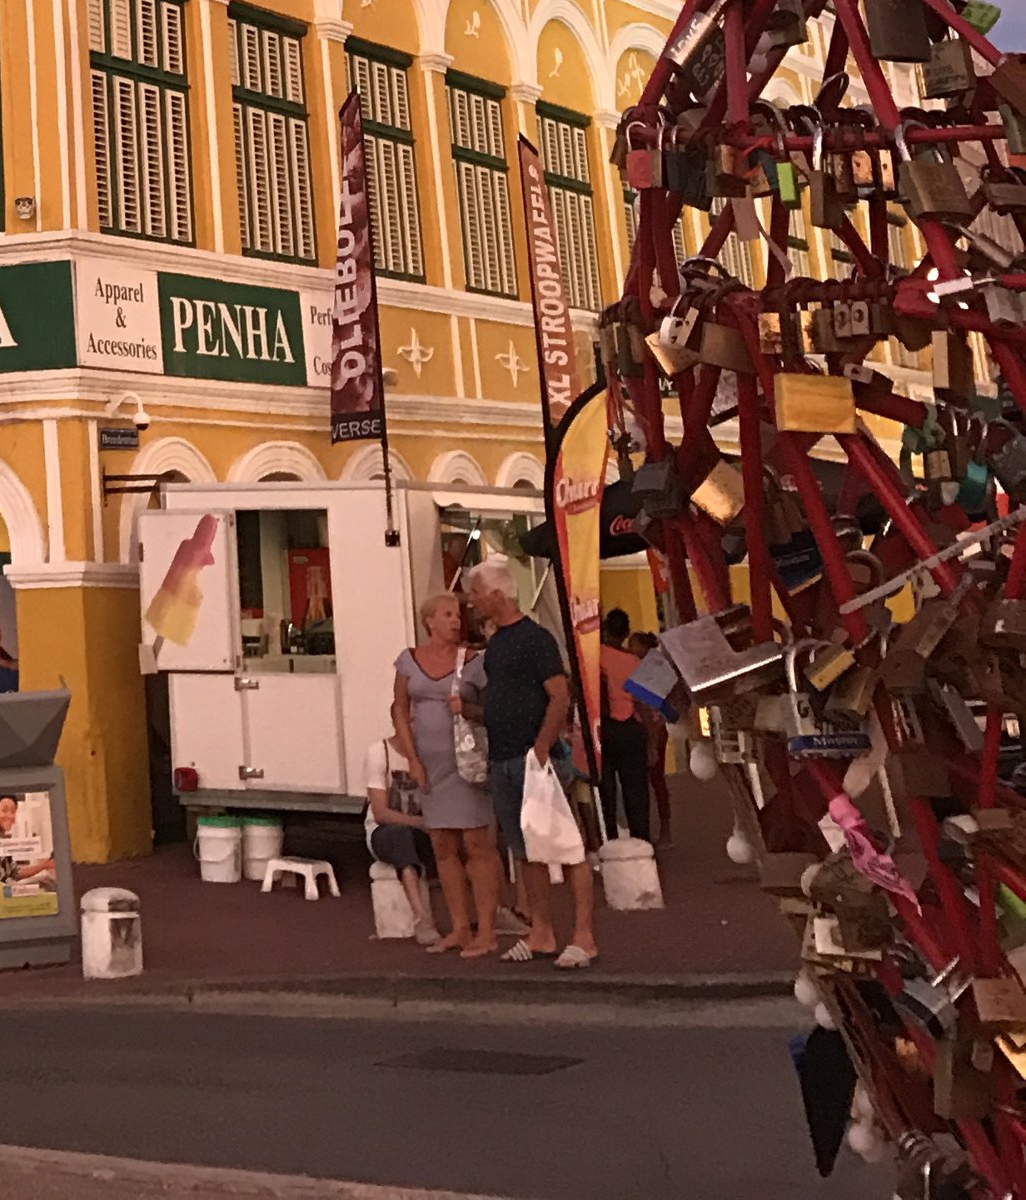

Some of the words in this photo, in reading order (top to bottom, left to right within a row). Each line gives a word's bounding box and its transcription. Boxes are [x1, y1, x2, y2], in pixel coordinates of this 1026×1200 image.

[94, 277, 144, 305] Apparel
[115, 308, 127, 328] &
[170, 296, 296, 364] PENHA
[87, 332, 158, 361] Accessories
[548, 373, 572, 406] XL
